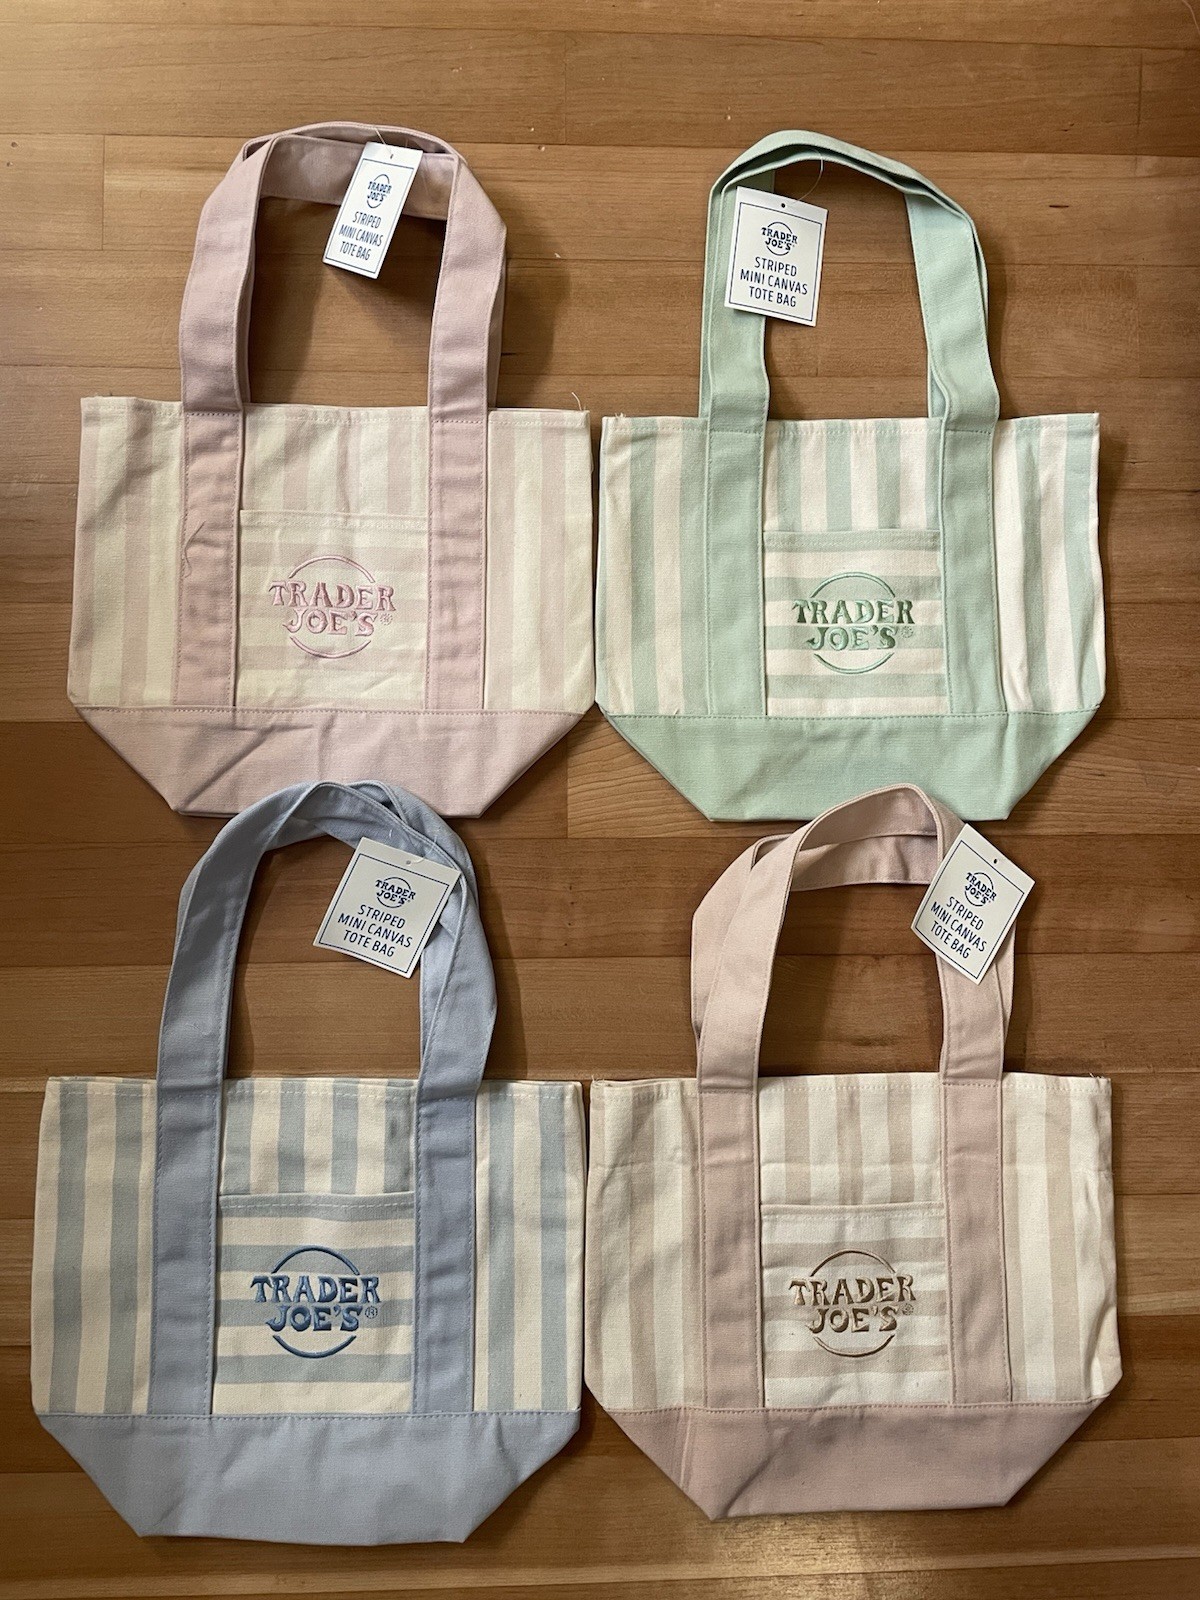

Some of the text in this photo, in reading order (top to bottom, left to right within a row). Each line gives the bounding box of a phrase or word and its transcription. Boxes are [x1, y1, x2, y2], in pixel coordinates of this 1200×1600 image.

[368, 181, 392, 194] TRADER
[352, 211, 382, 229] STRIPED
[338, 224, 384, 247] MINI CANVAS
[761, 227, 798, 244] TRADER
[339, 241, 371, 261] TOTE BAG
[754, 257, 797, 277] STRIPED
[740, 268, 808, 295] MINI CANVAS
[749, 286, 797, 308] TOTE BAG
[268, 580, 396, 611] TRADER
[791, 599, 915, 625] TRADER
[375, 879, 416, 900] TRADER
[965, 872, 997, 902] TRADER
[357, 904, 406, 929] STRIPED
[930, 901, 987, 952] MINI CANVAS
[946, 896, 984, 931] STRIPED
[337, 913, 413, 948] MINI CANVAS
[343, 929, 396, 957] TOTE BAG
[930, 921, 971, 959] TOTE BAG
[250, 1275, 381, 1304] TRADER
[788, 1274, 916, 1306] TRADER
